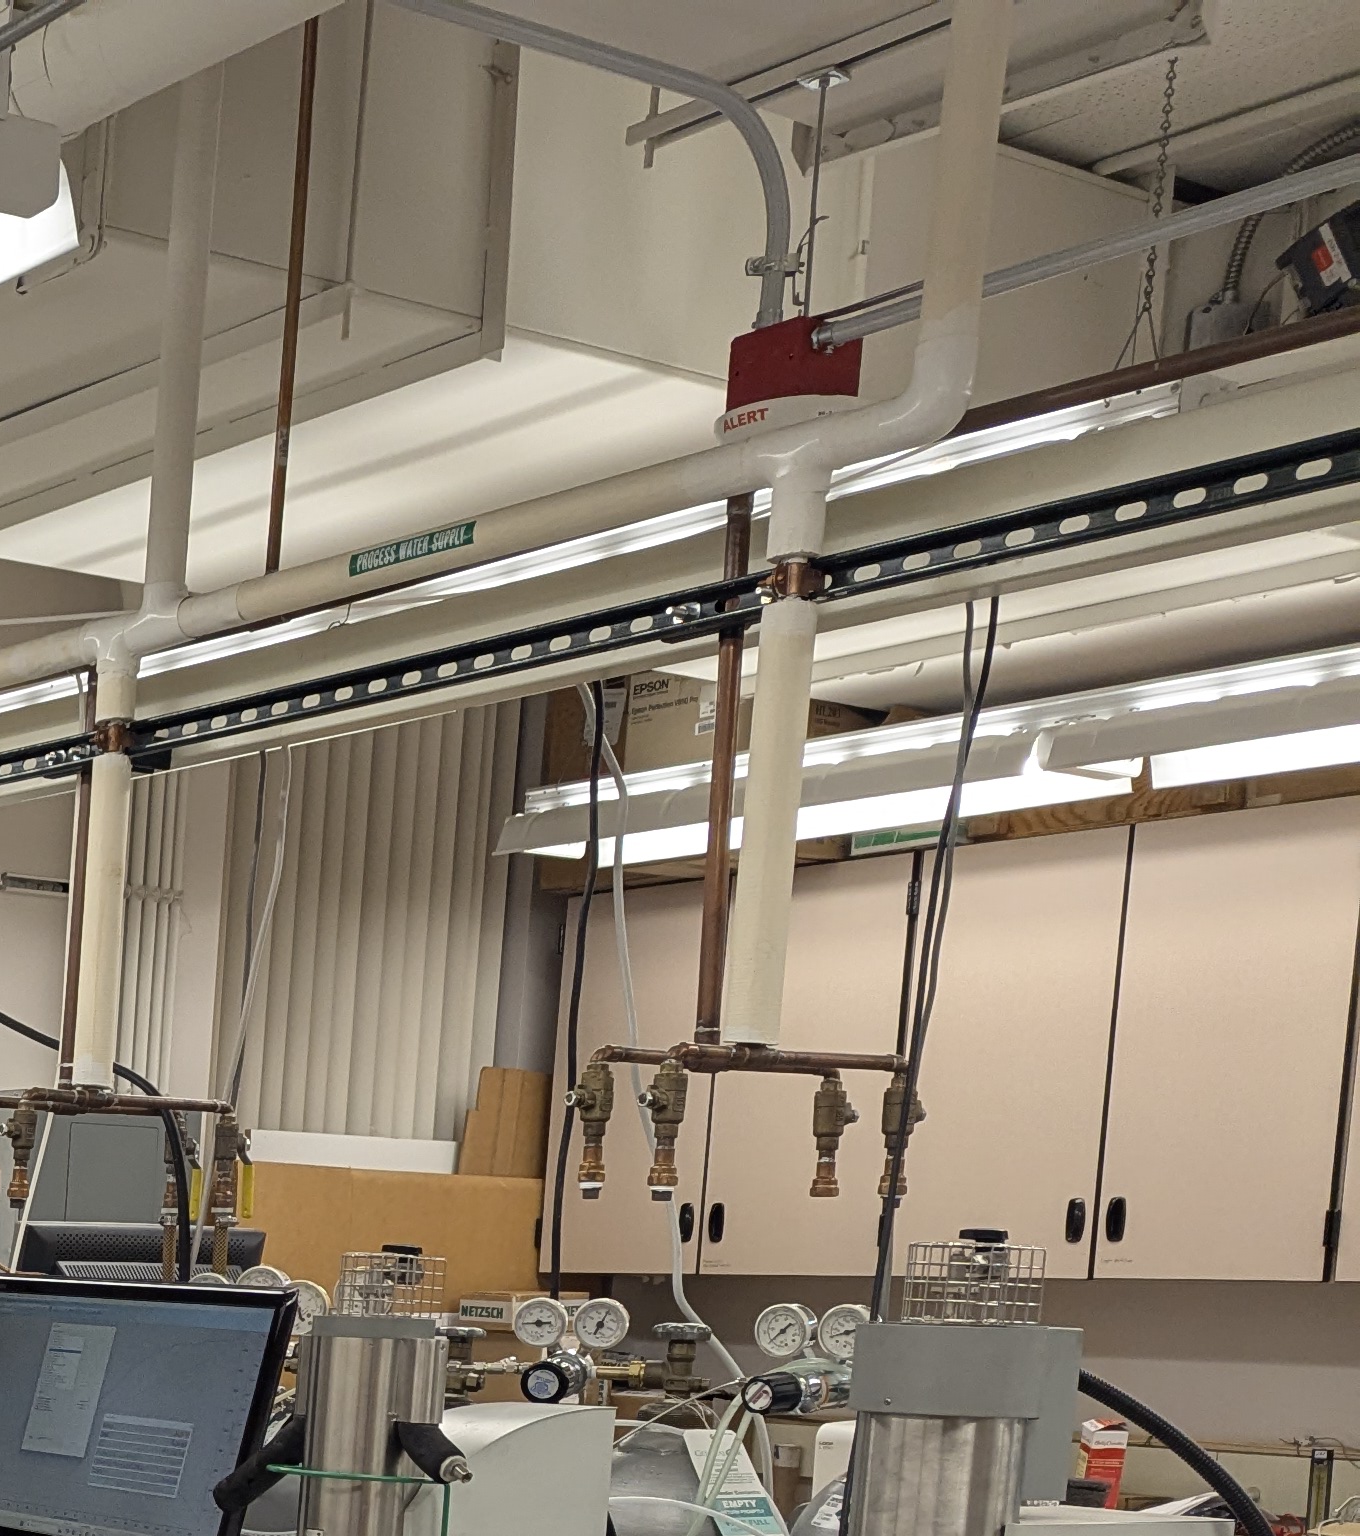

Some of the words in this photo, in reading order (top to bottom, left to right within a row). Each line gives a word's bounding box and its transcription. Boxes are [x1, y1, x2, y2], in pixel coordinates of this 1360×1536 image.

[723, 407, 769, 434] ALERT
[356, 544, 397, 573] PROCESS
[399, 535, 430, 560] WATER
[432, 525, 467, 552] SUPPLY
[632, 679, 670, 696] EPSON
[461, 1305, 504, 1319] NETZSCH
[721, 1500, 758, 1508] EMPTY
